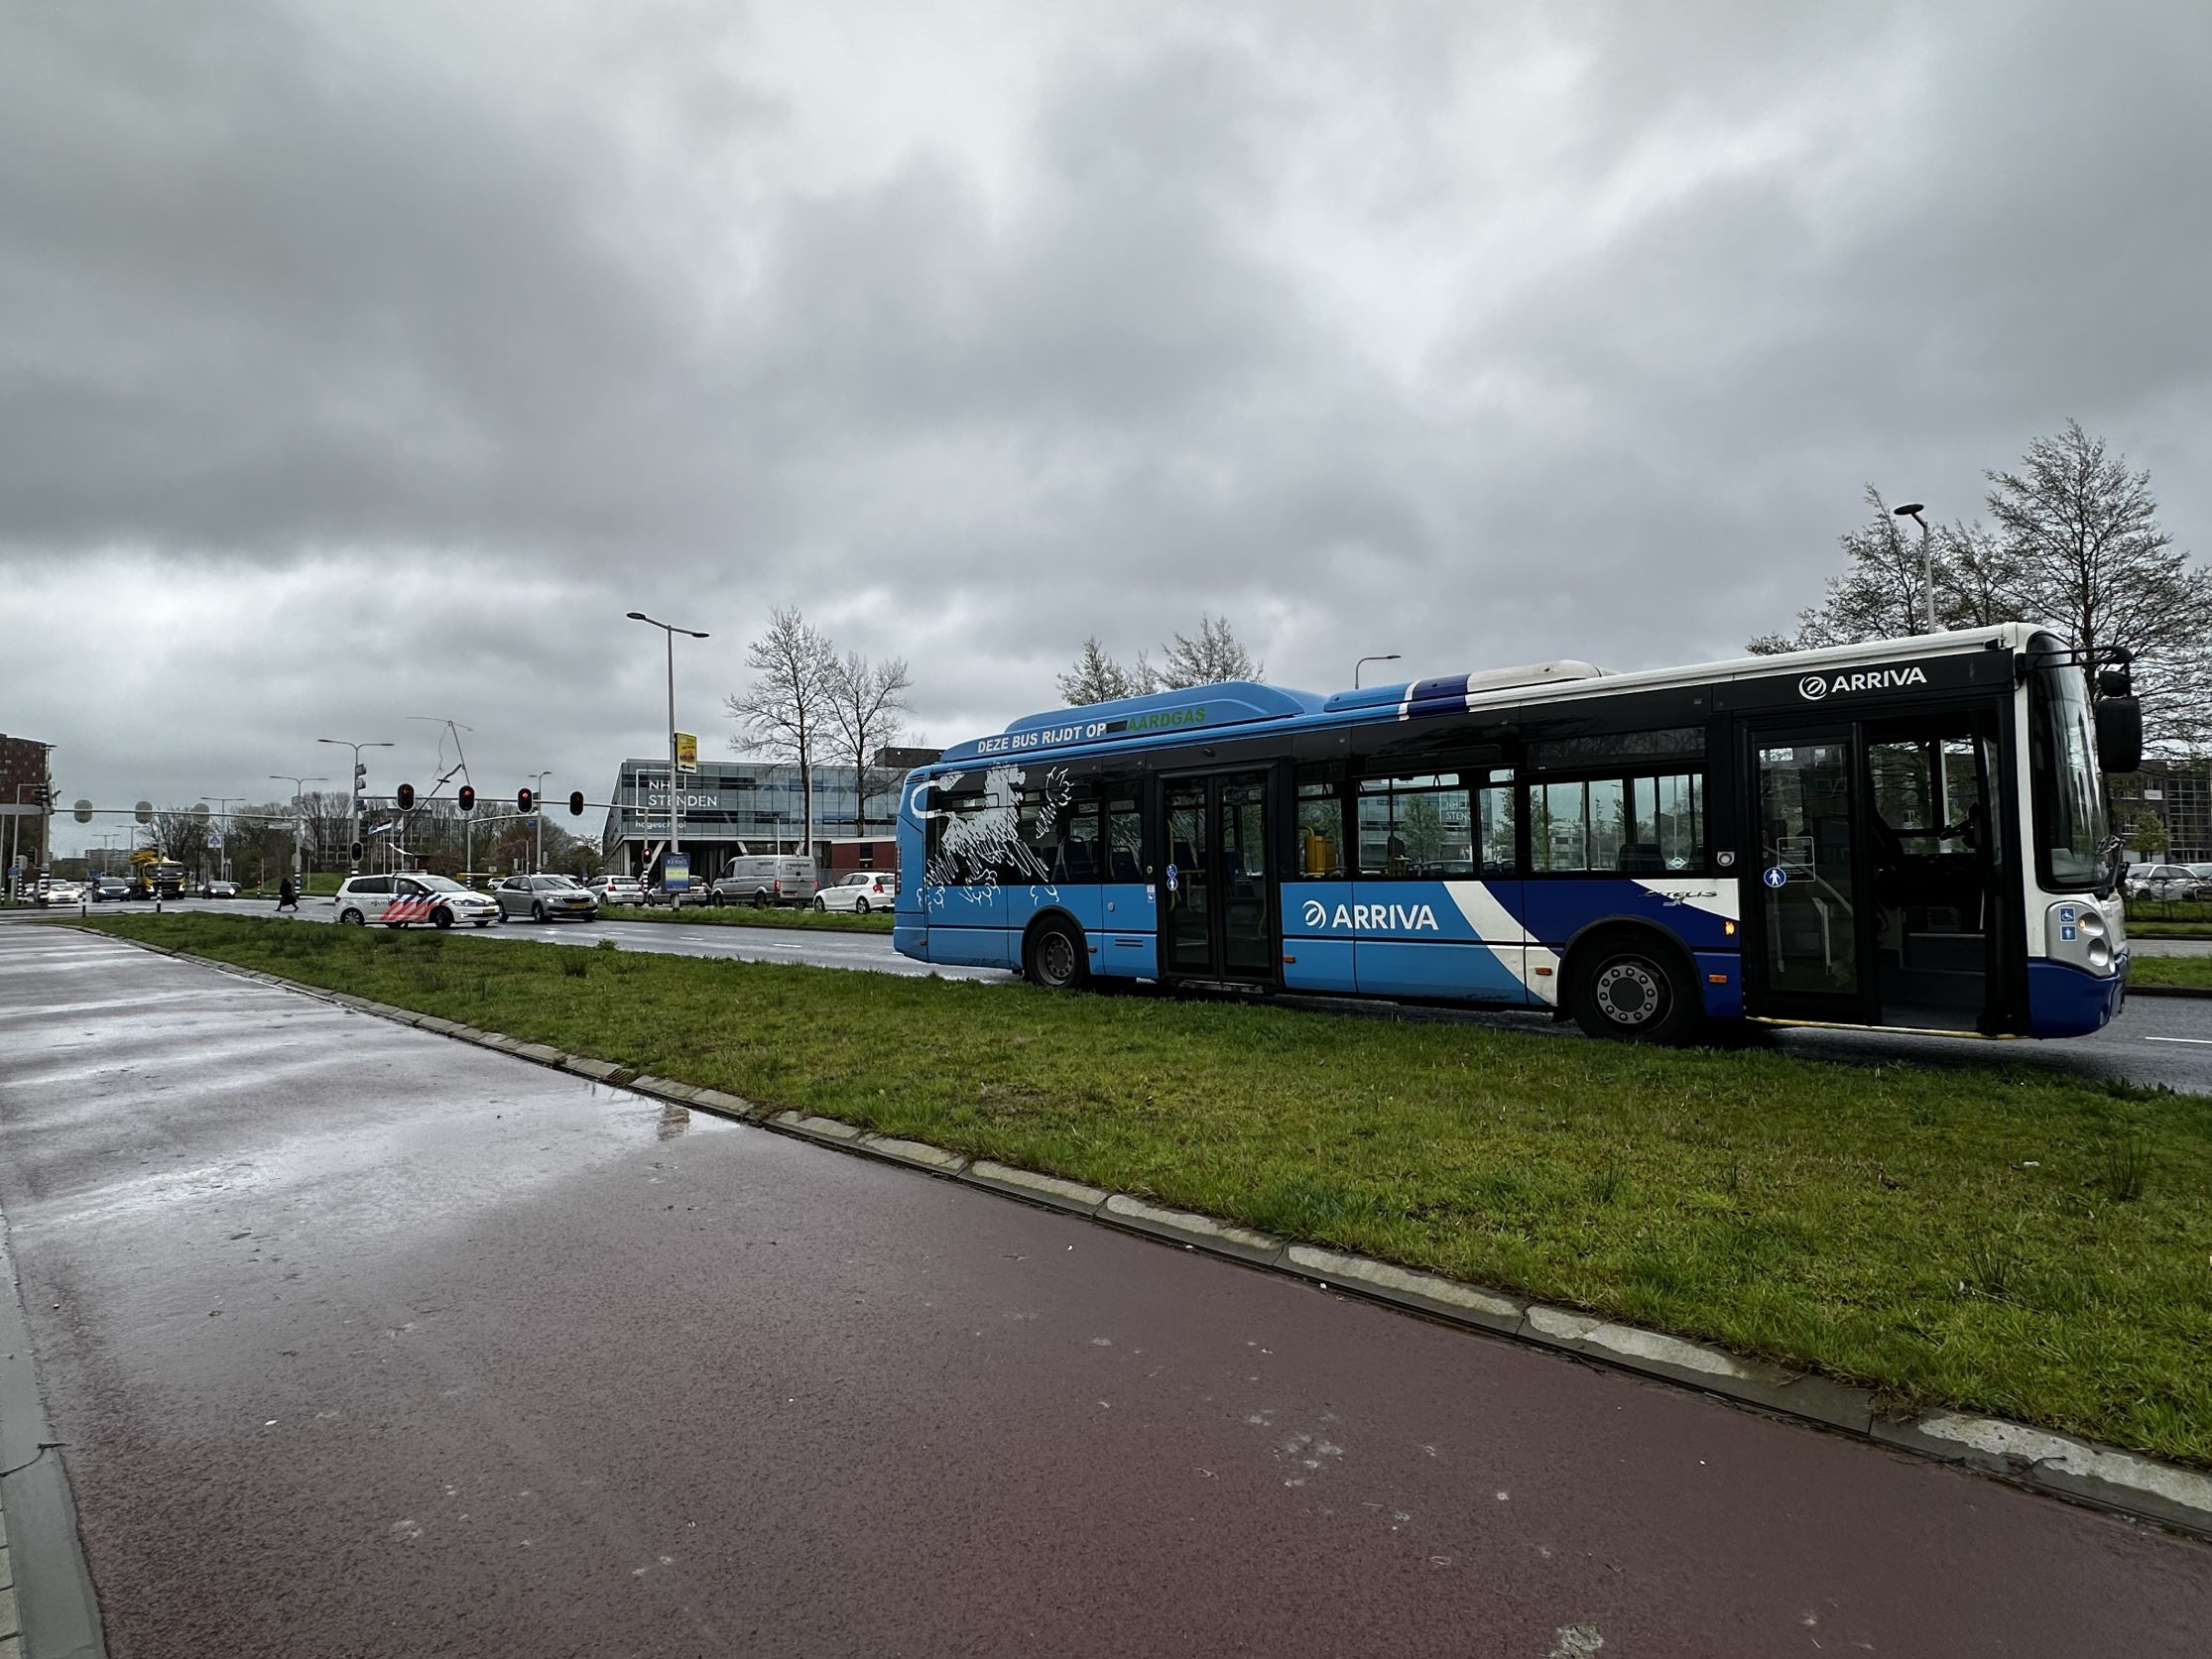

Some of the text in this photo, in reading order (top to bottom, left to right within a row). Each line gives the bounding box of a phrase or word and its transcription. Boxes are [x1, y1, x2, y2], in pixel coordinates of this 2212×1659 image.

[1831, 666, 1927, 693] ARRIVA
[977, 708, 1205, 753] DEZE BUS RIJDT OP AARDGAS
[635, 820, 686, 829] hogeschol
[1331, 903, 1439, 930] ARRIVA
